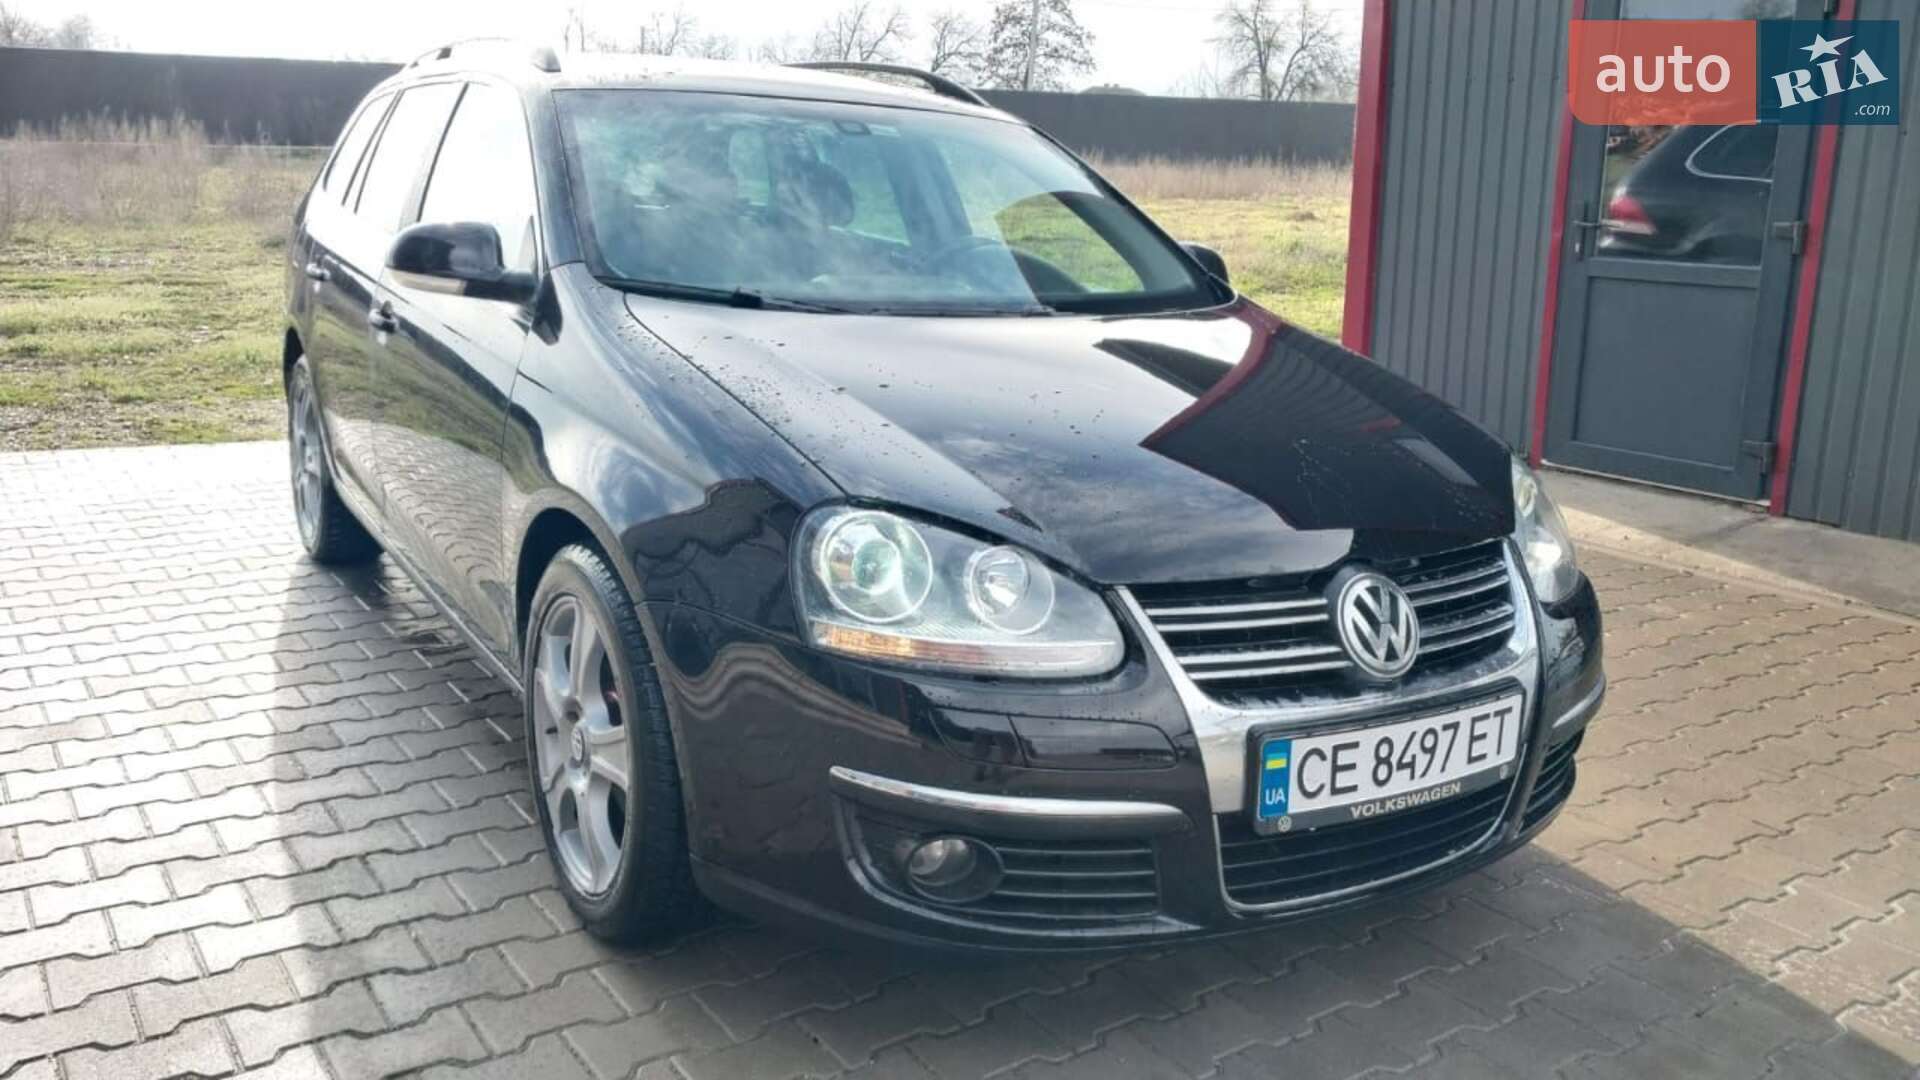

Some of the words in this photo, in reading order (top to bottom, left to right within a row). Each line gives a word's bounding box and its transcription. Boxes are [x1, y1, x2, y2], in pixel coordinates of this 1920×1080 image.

[1343, 576, 1416, 670] VW
[1297, 741, 1360, 799] CE
[1372, 721, 1461, 787] 8497
[1467, 707, 1513, 765] ET
[1265, 788, 1286, 805] UA
[1351, 781, 1461, 819] VOLKSWAGEN
